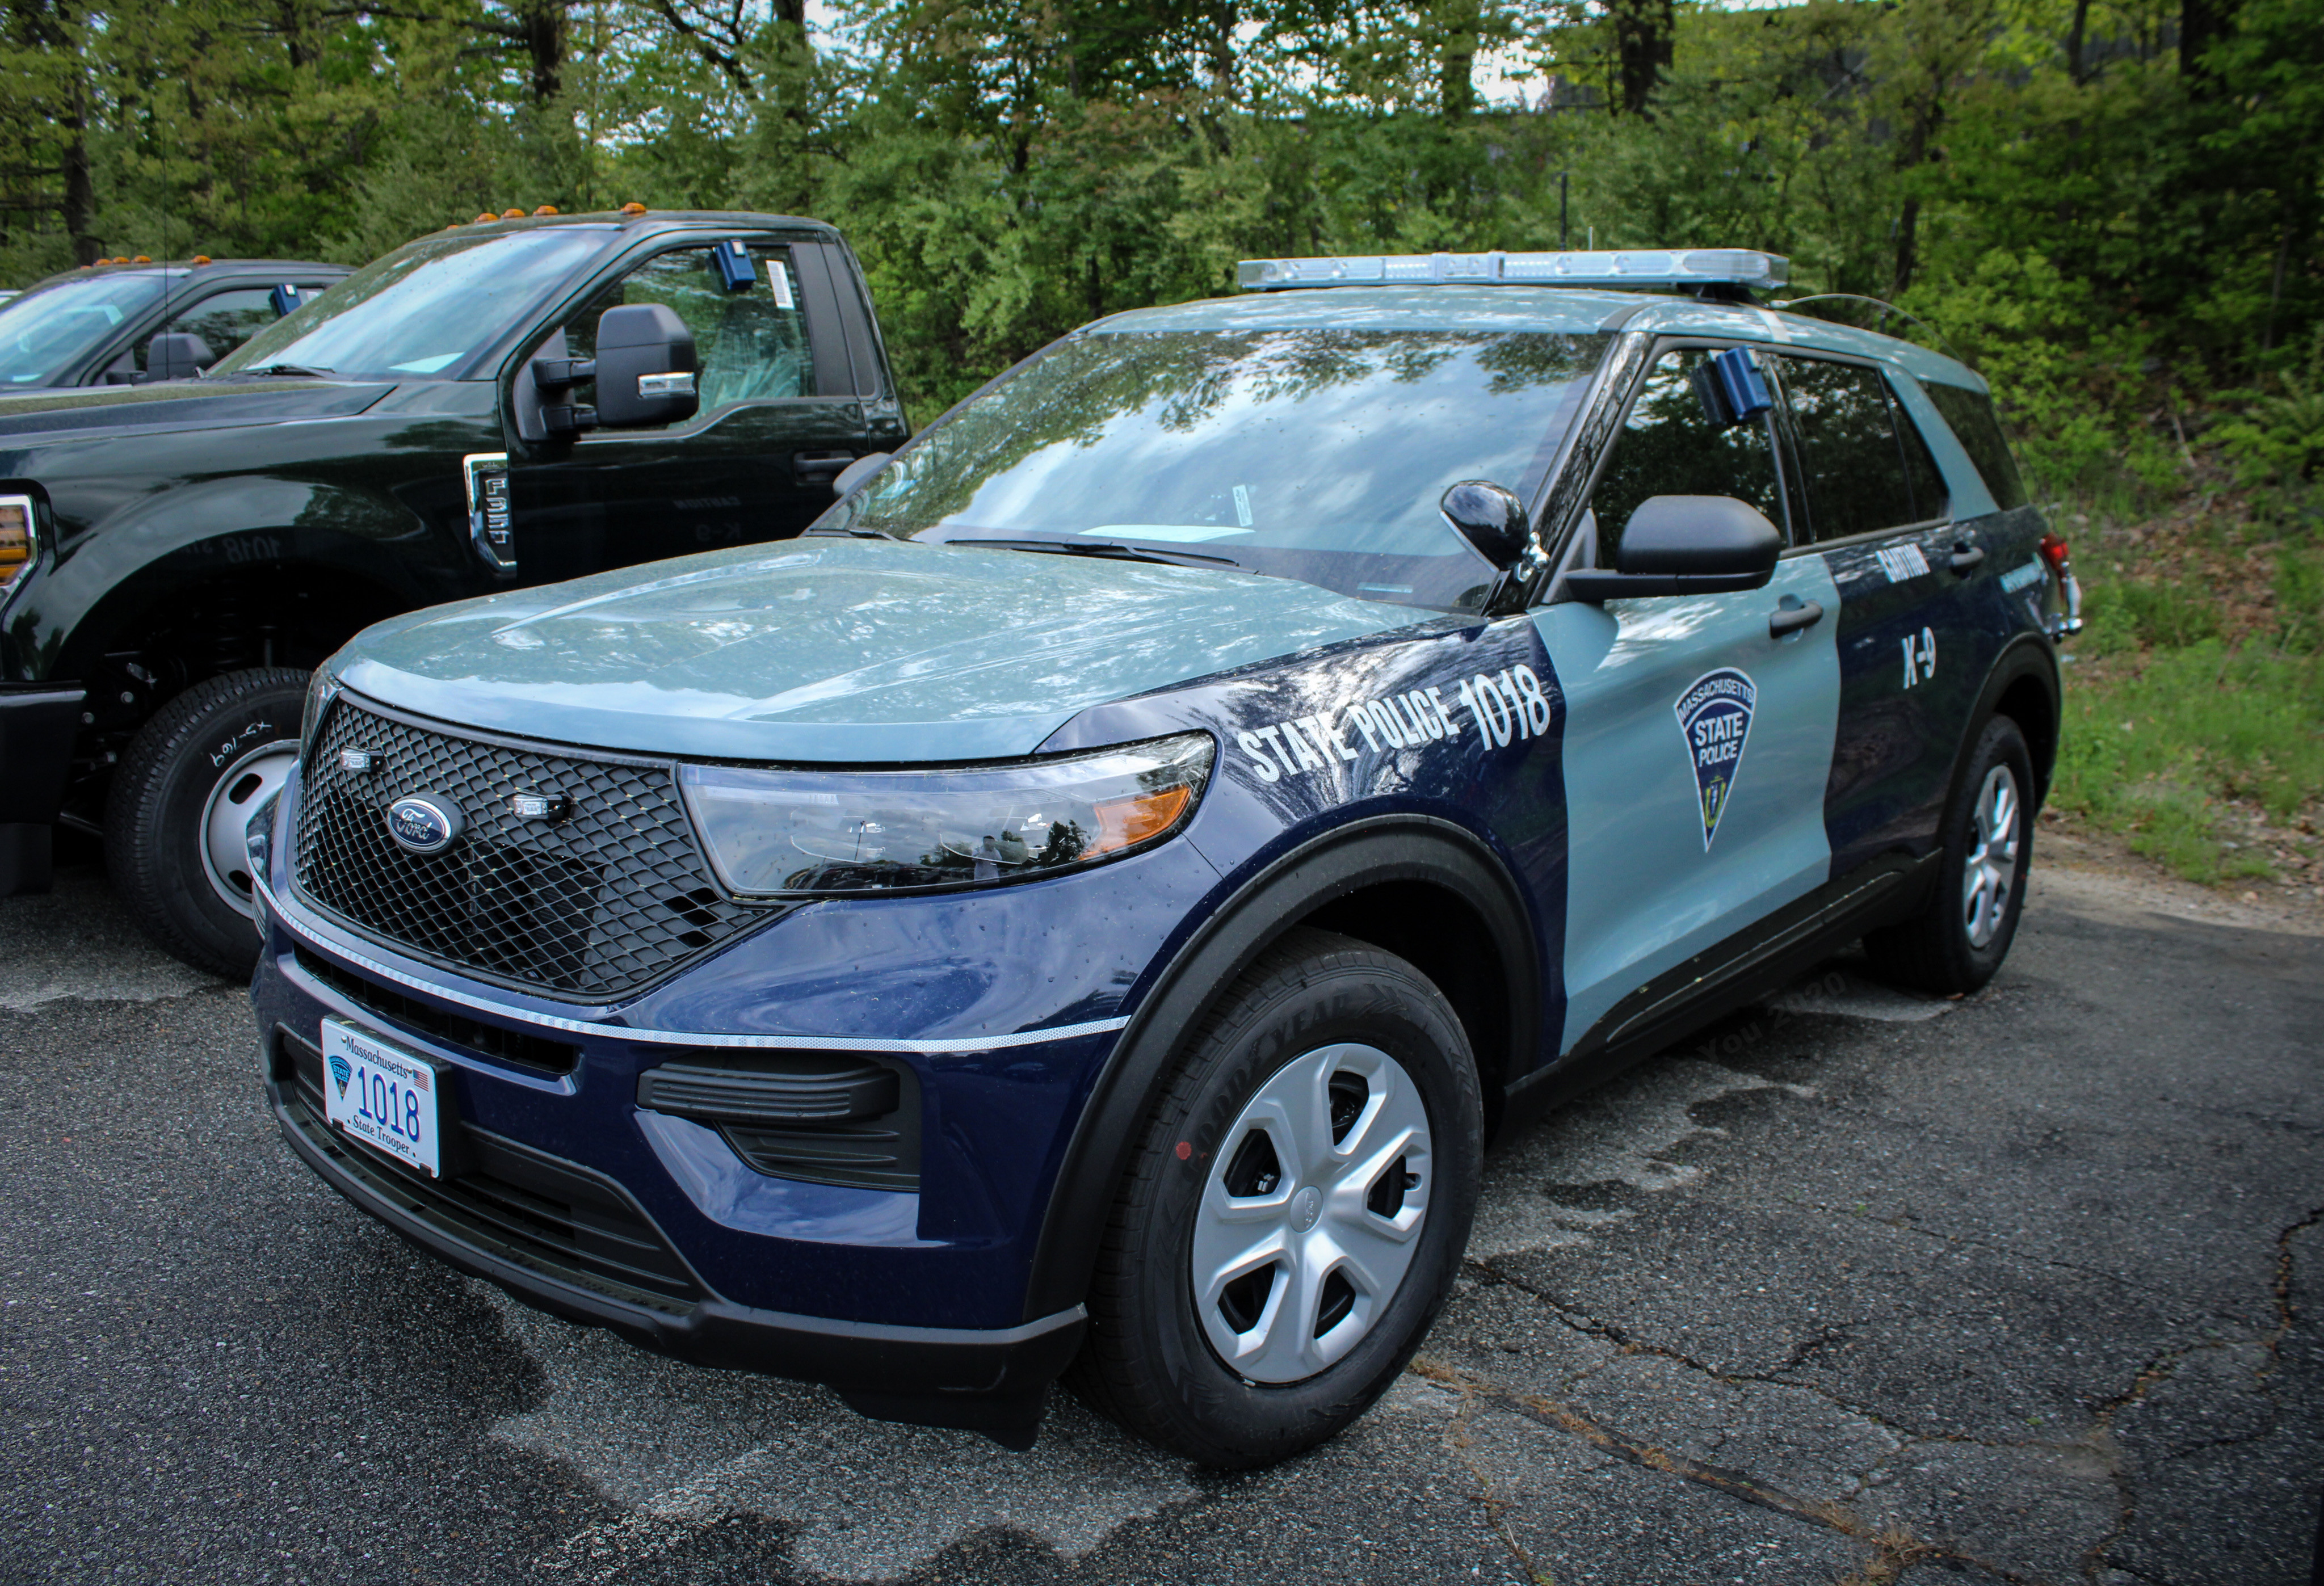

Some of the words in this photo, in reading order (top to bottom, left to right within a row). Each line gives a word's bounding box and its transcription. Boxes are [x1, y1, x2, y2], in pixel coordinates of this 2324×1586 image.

[1901, 626, 1936, 689] K-9
[1678, 678, 1754, 722] MASSACHUSETTS
[1237, 710, 1359, 783] STATE
[1346, 685, 1460, 753] POLICE
[1459, 663, 1551, 751] 1018
[1695, 711, 1744, 747] STATE
[1698, 739, 1739, 768] POLICE
[397, 808, 433, 840] Ford
[333, 1065, 350, 1078] STATE
[346, 1036, 409, 1079] Massachusetts
[358, 1064, 421, 1142] 1018
[353, 1114, 375, 1136] State
[377, 1126, 410, 1155] Trooper
